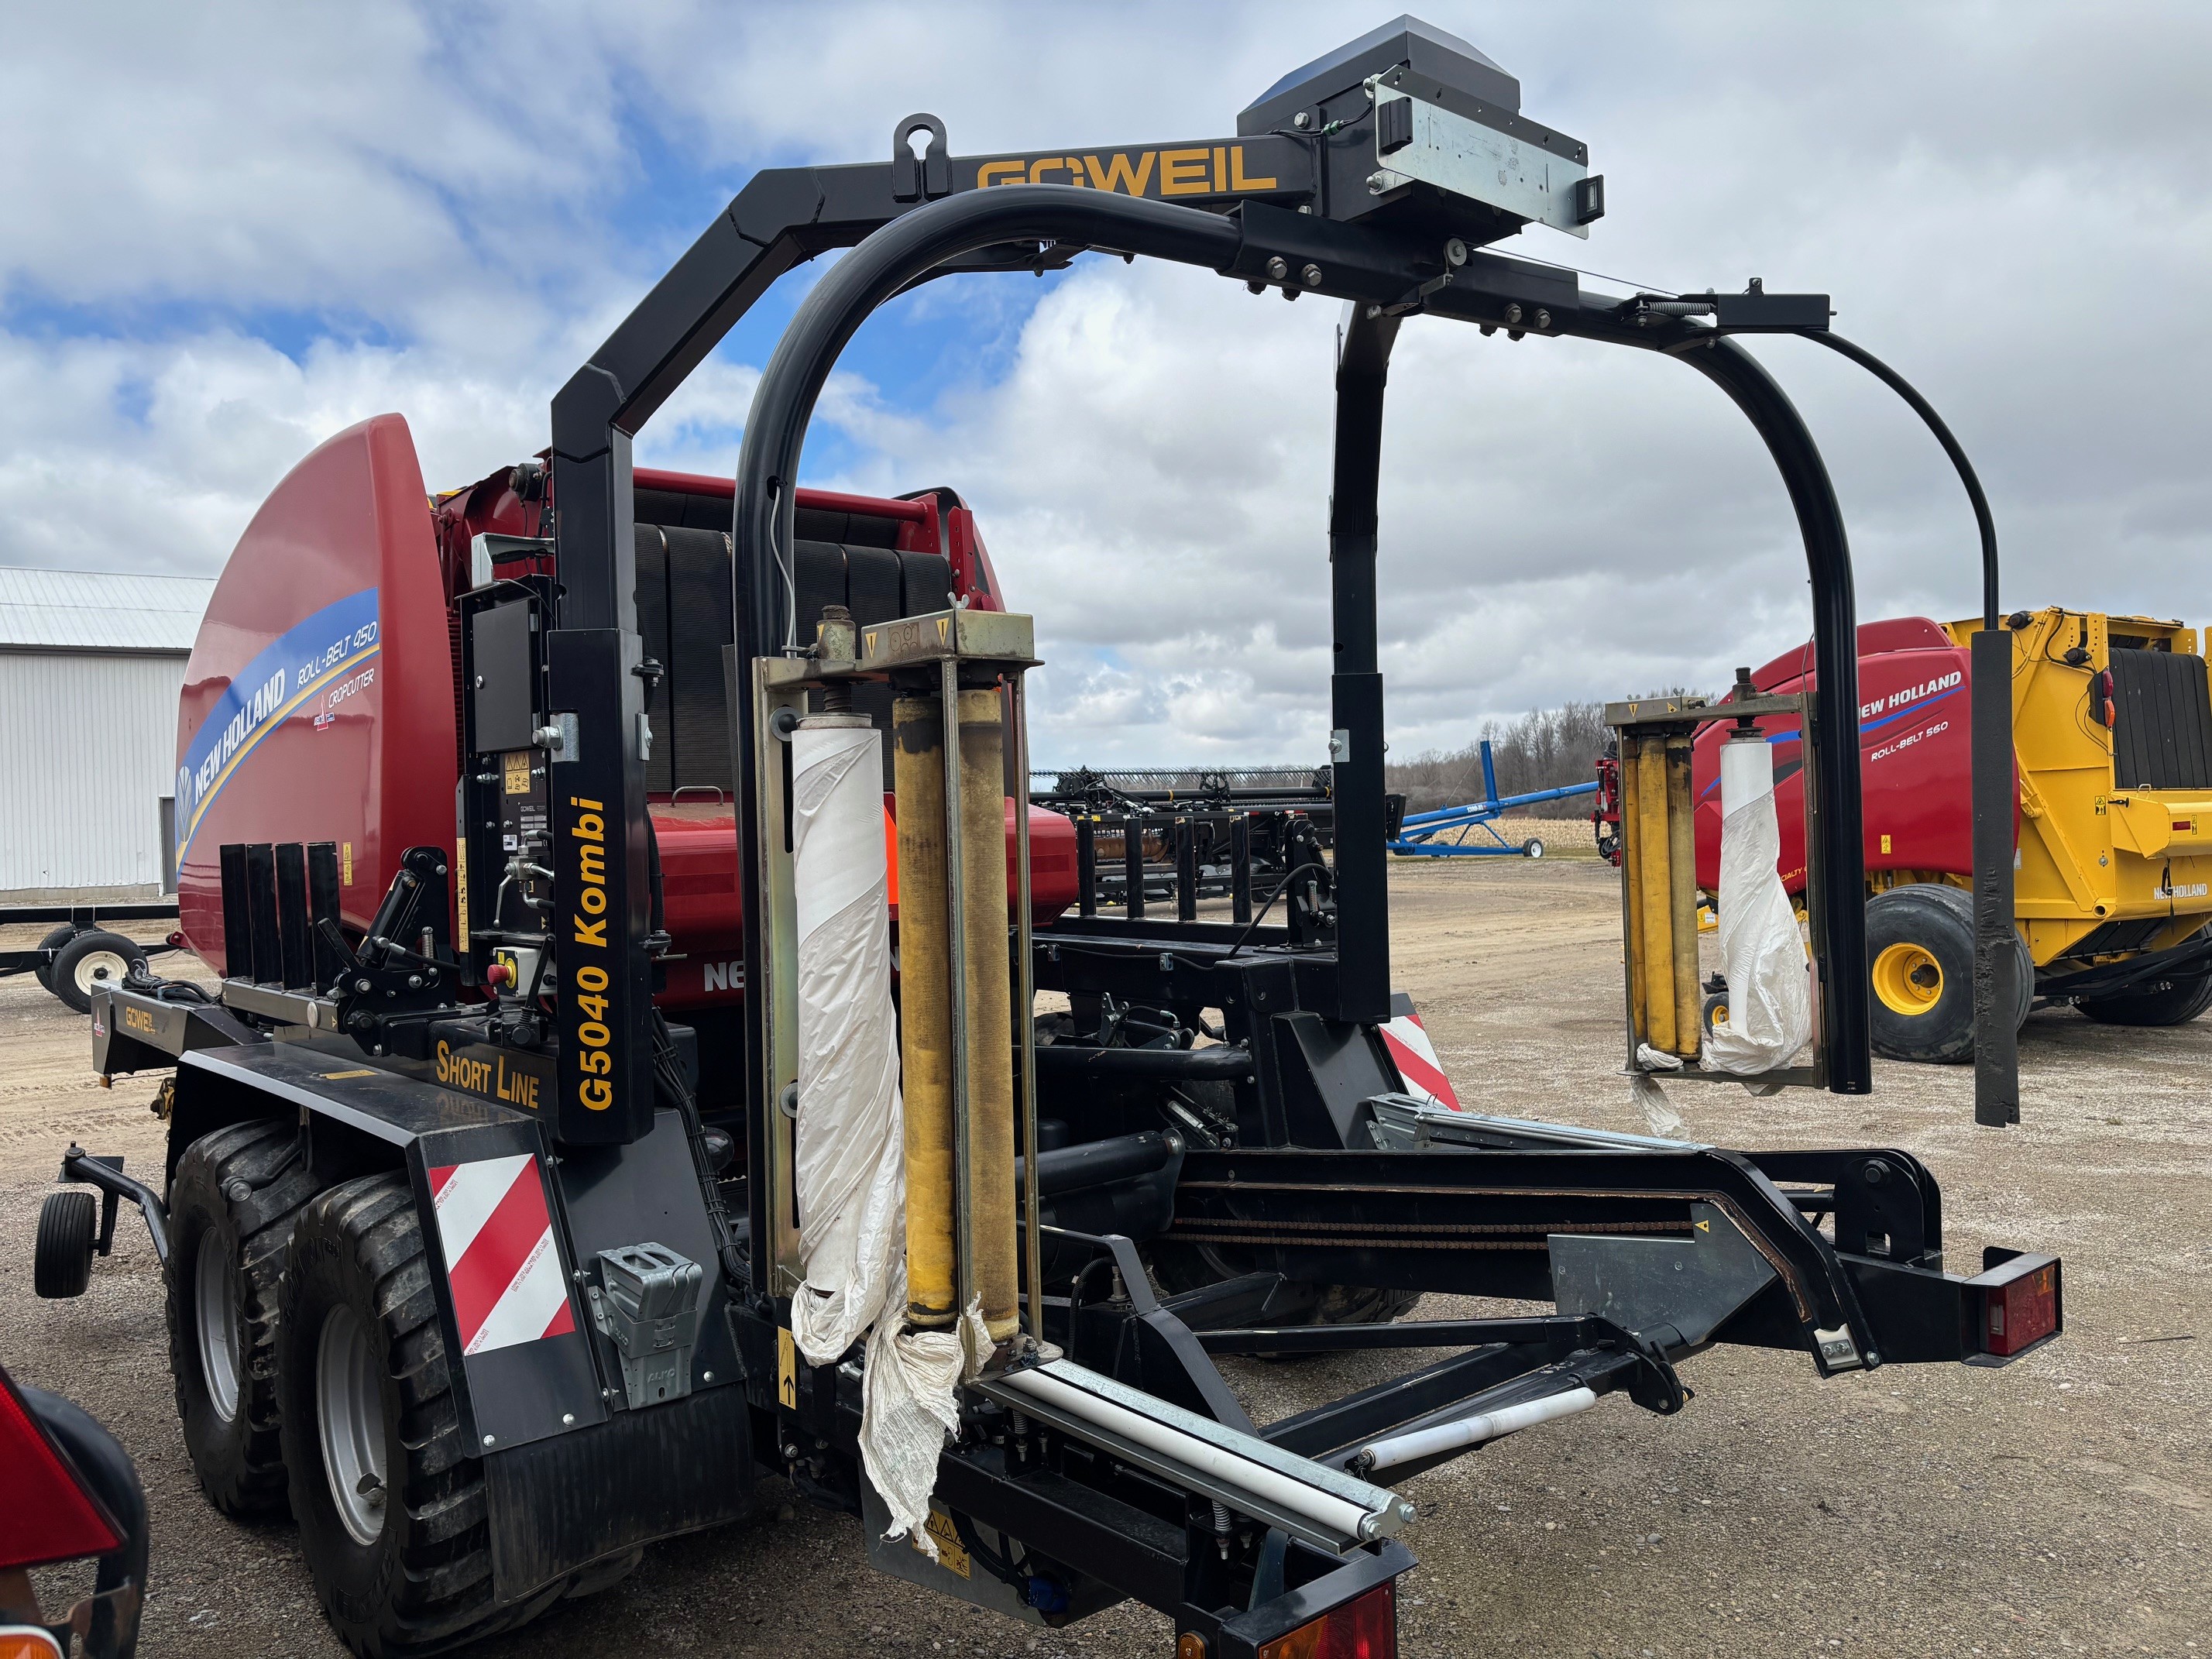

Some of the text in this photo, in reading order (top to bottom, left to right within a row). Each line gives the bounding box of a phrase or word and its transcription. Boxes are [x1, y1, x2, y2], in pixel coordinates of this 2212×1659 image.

[297, 620, 377, 689] ROLL-BELT 450
[328, 668, 374, 709] CROPCUTTER
[1888, 671, 1962, 709] HOLLAND
[195, 668, 286, 805] NEW HOLLAND
[1871, 721, 1949, 762] ROLL-BELT 560
[1781, 867, 1802, 882] CIALTY
[2154, 883, 2208, 900] NE HOLLAND
[570, 796, 613, 1111] G5040 Kombi
[704, 960, 745, 992] NE
